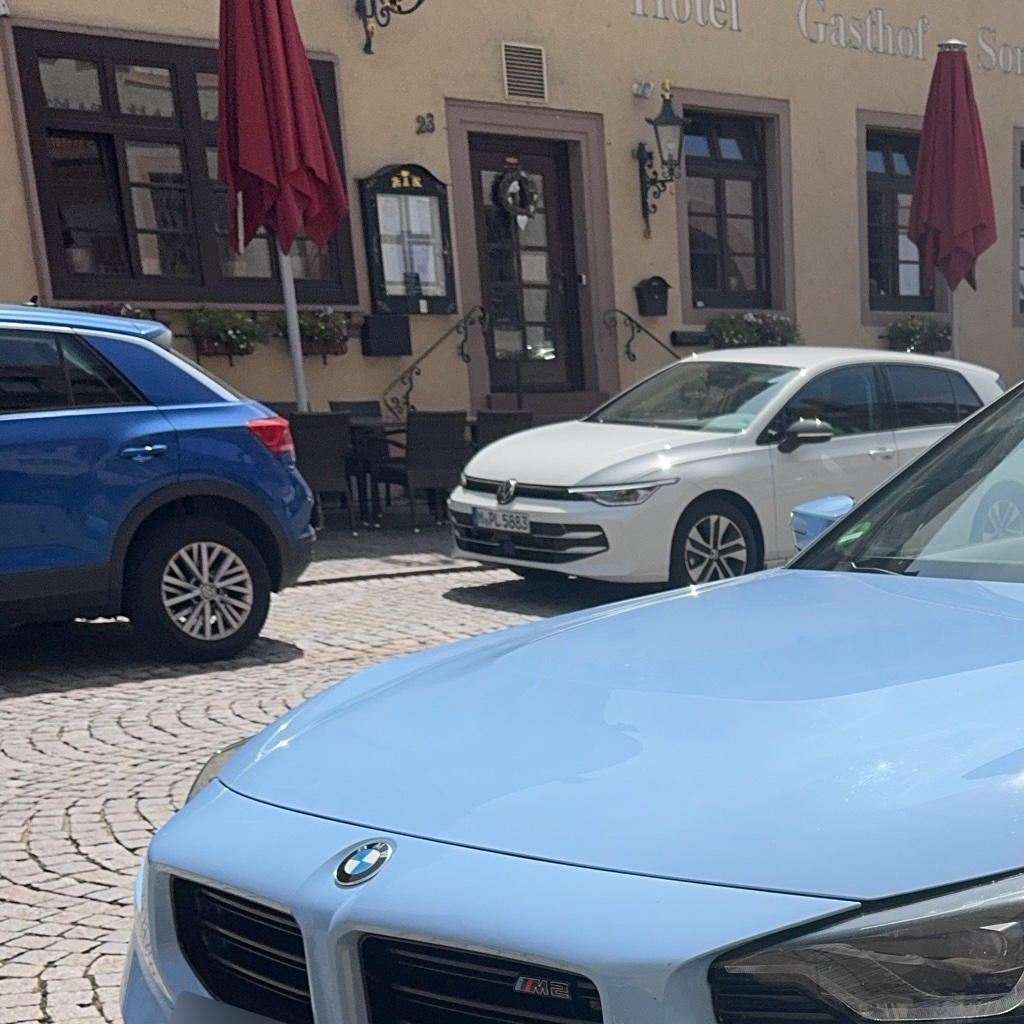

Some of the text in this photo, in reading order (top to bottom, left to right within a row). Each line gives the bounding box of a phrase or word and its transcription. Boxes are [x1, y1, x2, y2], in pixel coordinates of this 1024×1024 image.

[798, 0, 929, 61] Gasthof
[415, 112, 436, 135] 23
[531, 978, 571, 999] M2
